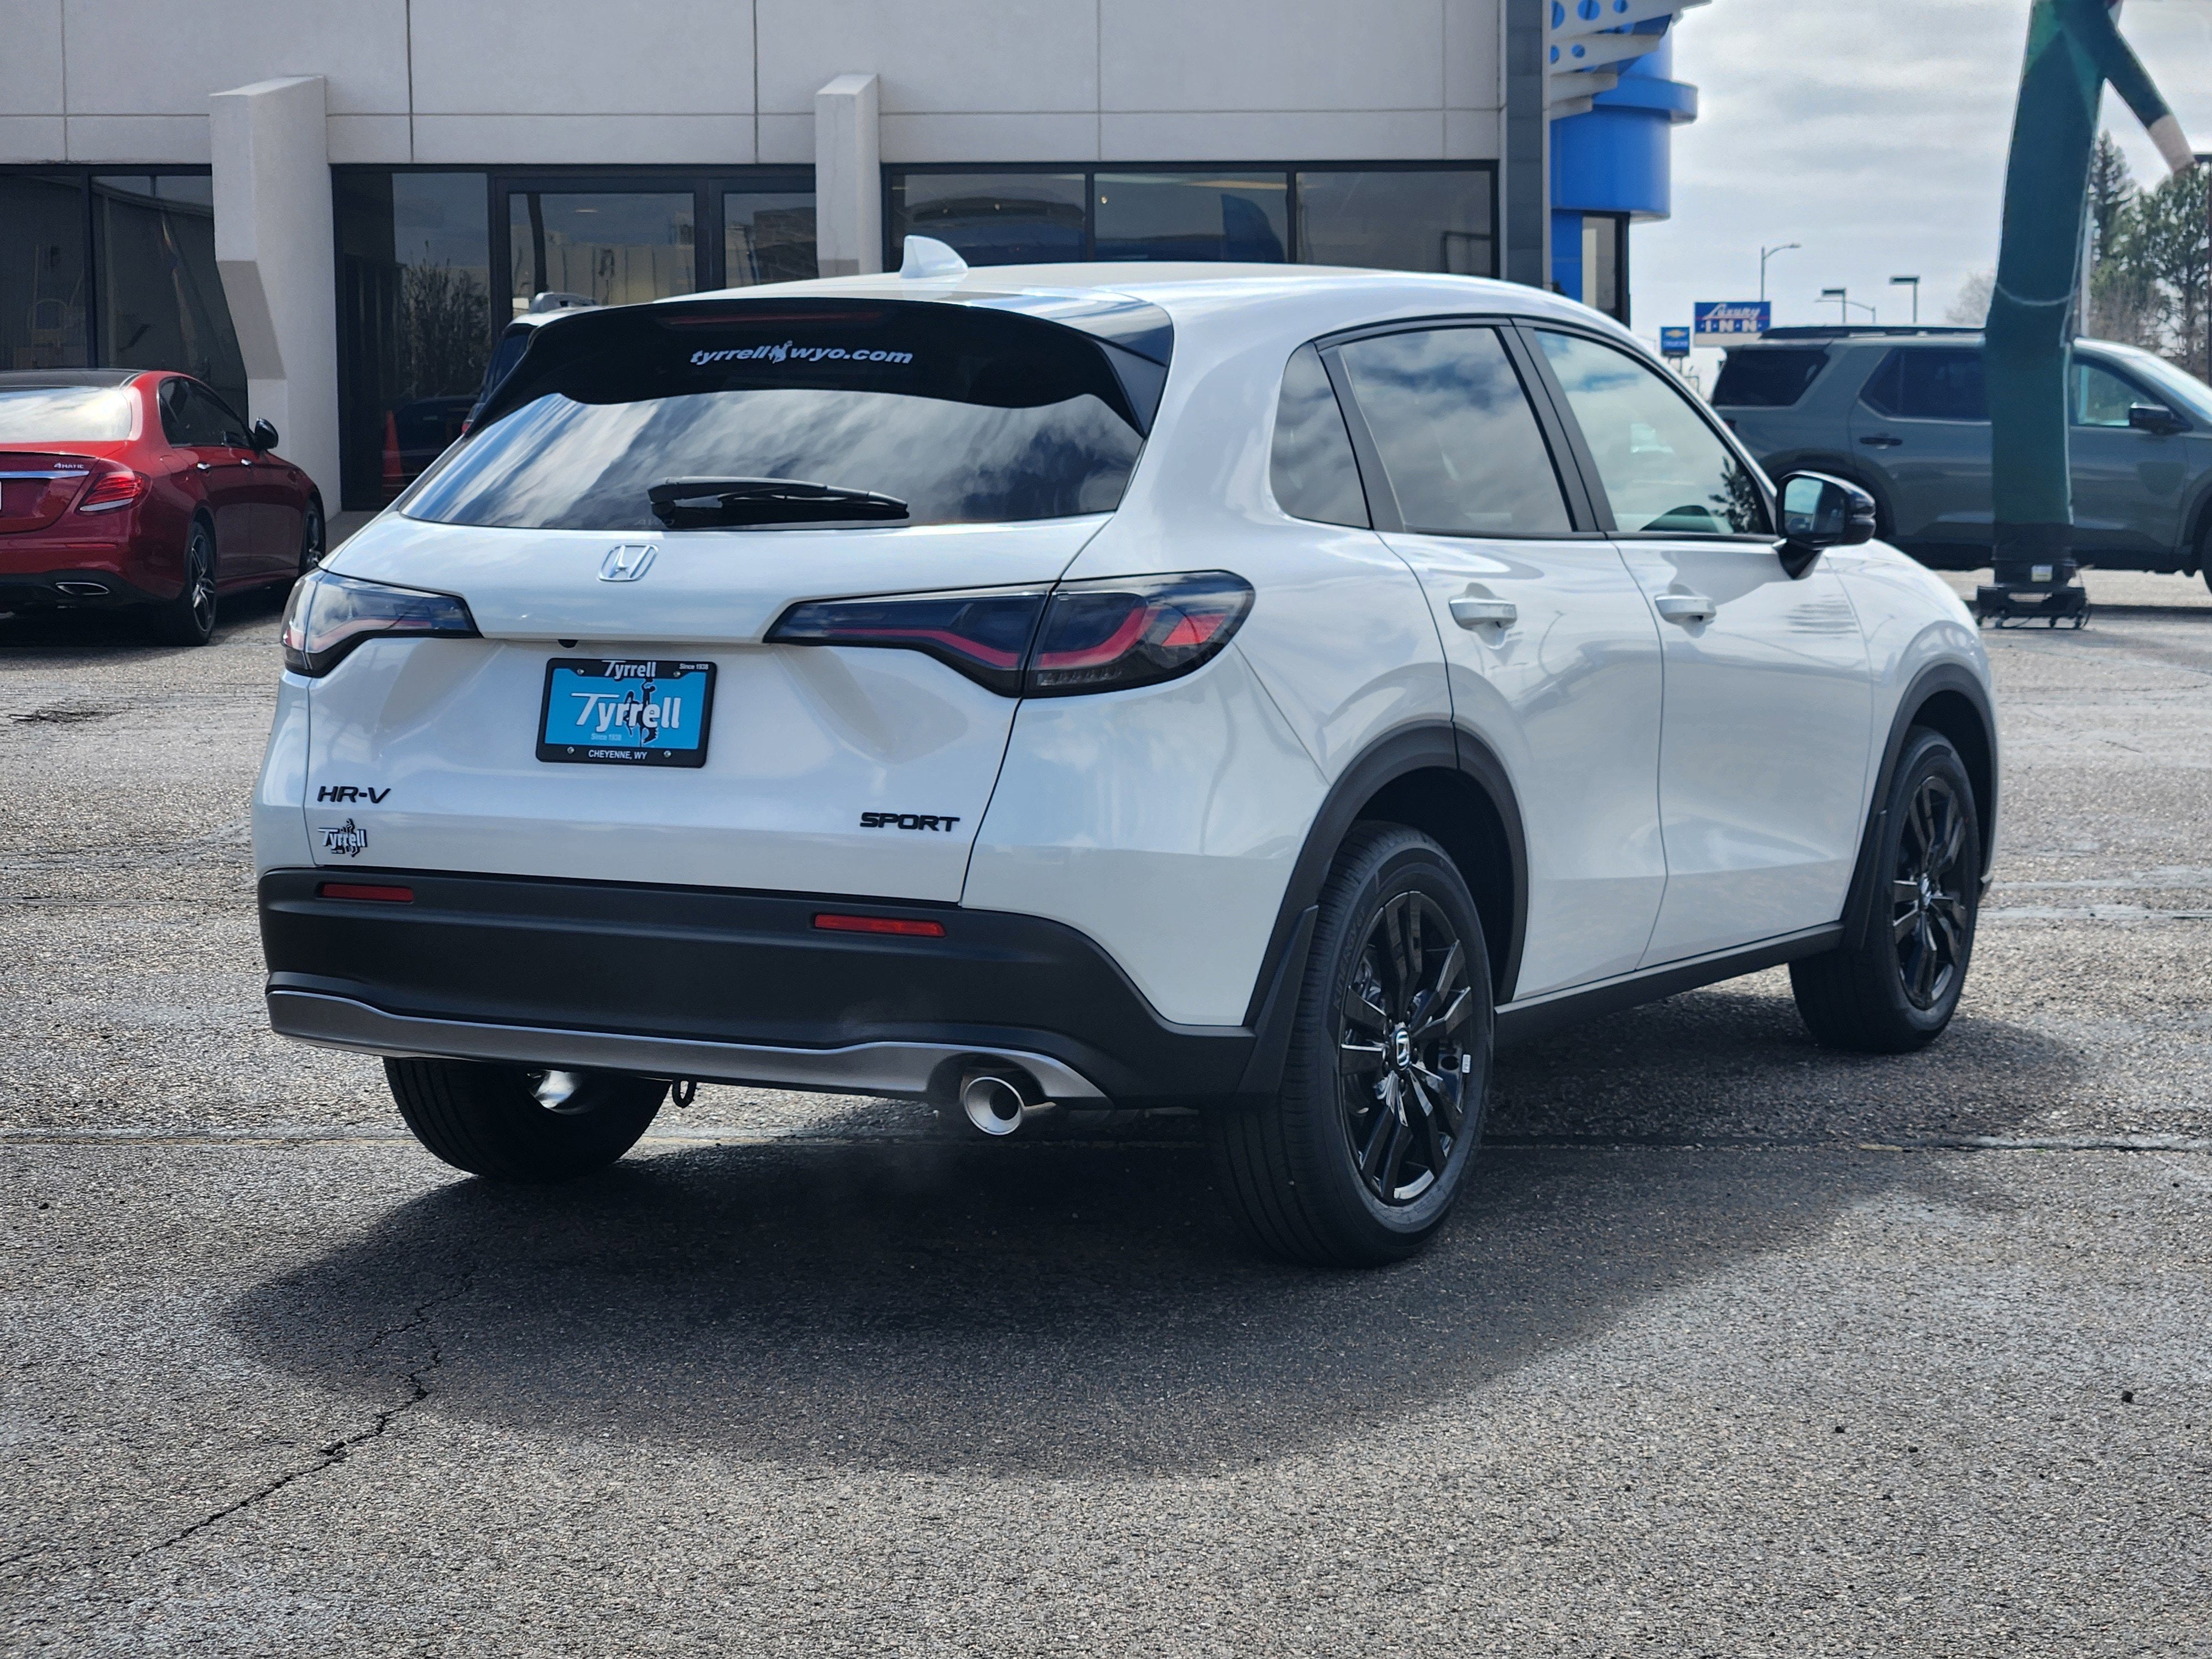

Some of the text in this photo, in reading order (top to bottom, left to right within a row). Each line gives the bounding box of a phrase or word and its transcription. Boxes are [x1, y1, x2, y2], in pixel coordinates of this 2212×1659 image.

[601, 660, 657, 680] Tyrrell
[571, 692, 682, 733] Tyrrell
[588, 749, 648, 760] CHEYENNE, WY
[317, 786, 392, 804] HR-V
[859, 812, 961, 832] SPORT
[317, 827, 368, 850] Tyrrell
